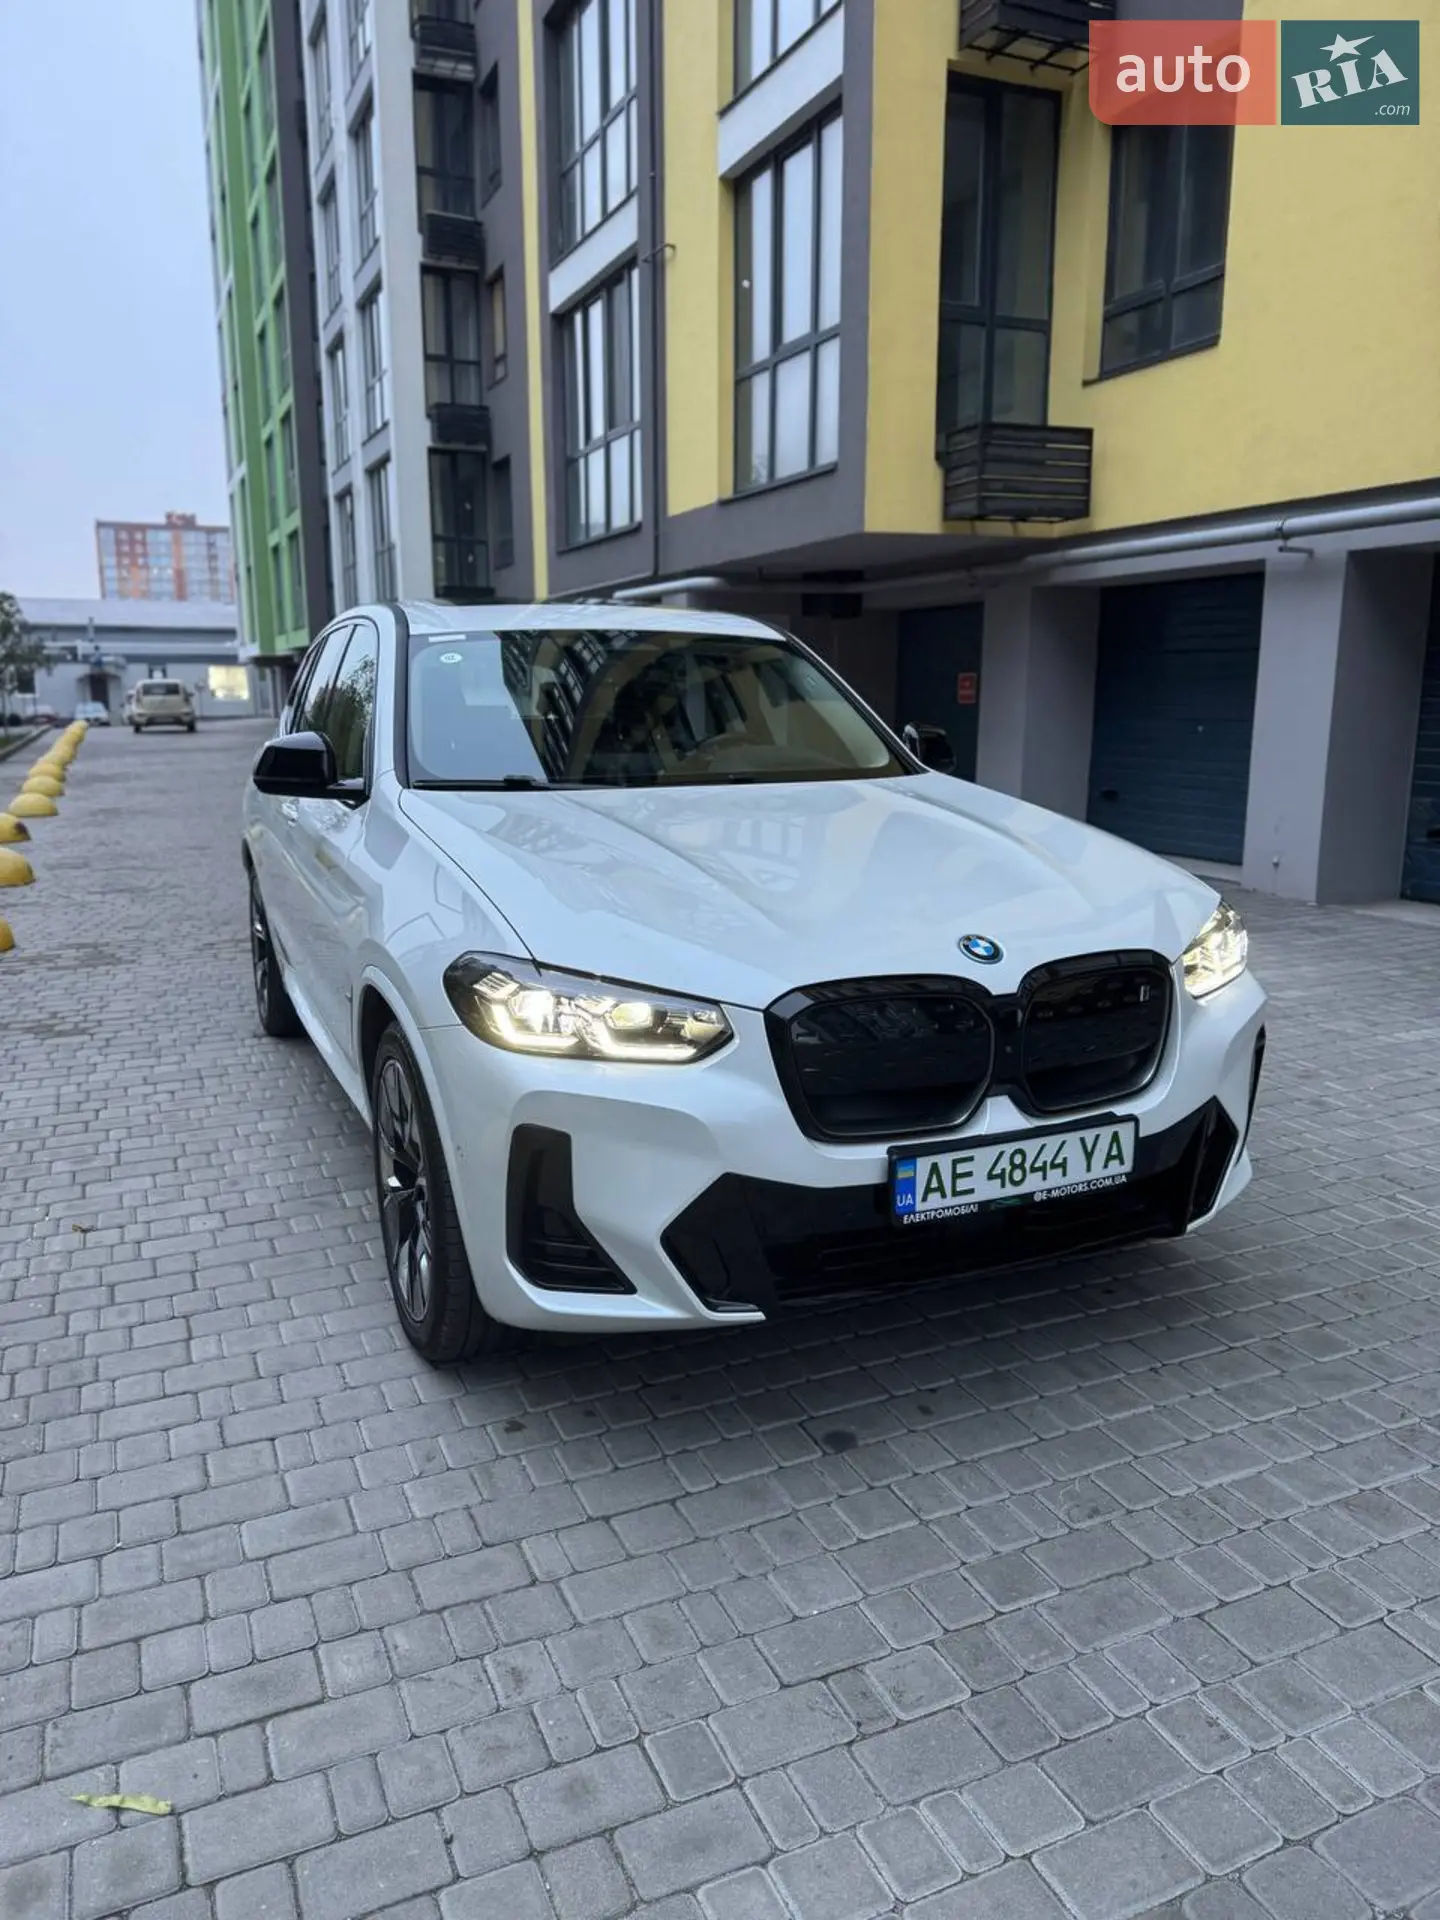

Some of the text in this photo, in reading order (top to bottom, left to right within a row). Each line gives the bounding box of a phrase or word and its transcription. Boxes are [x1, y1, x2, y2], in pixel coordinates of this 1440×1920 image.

[921, 1130, 1126, 1203] AE 4844 YA
[896, 1193, 914, 1207] UA
